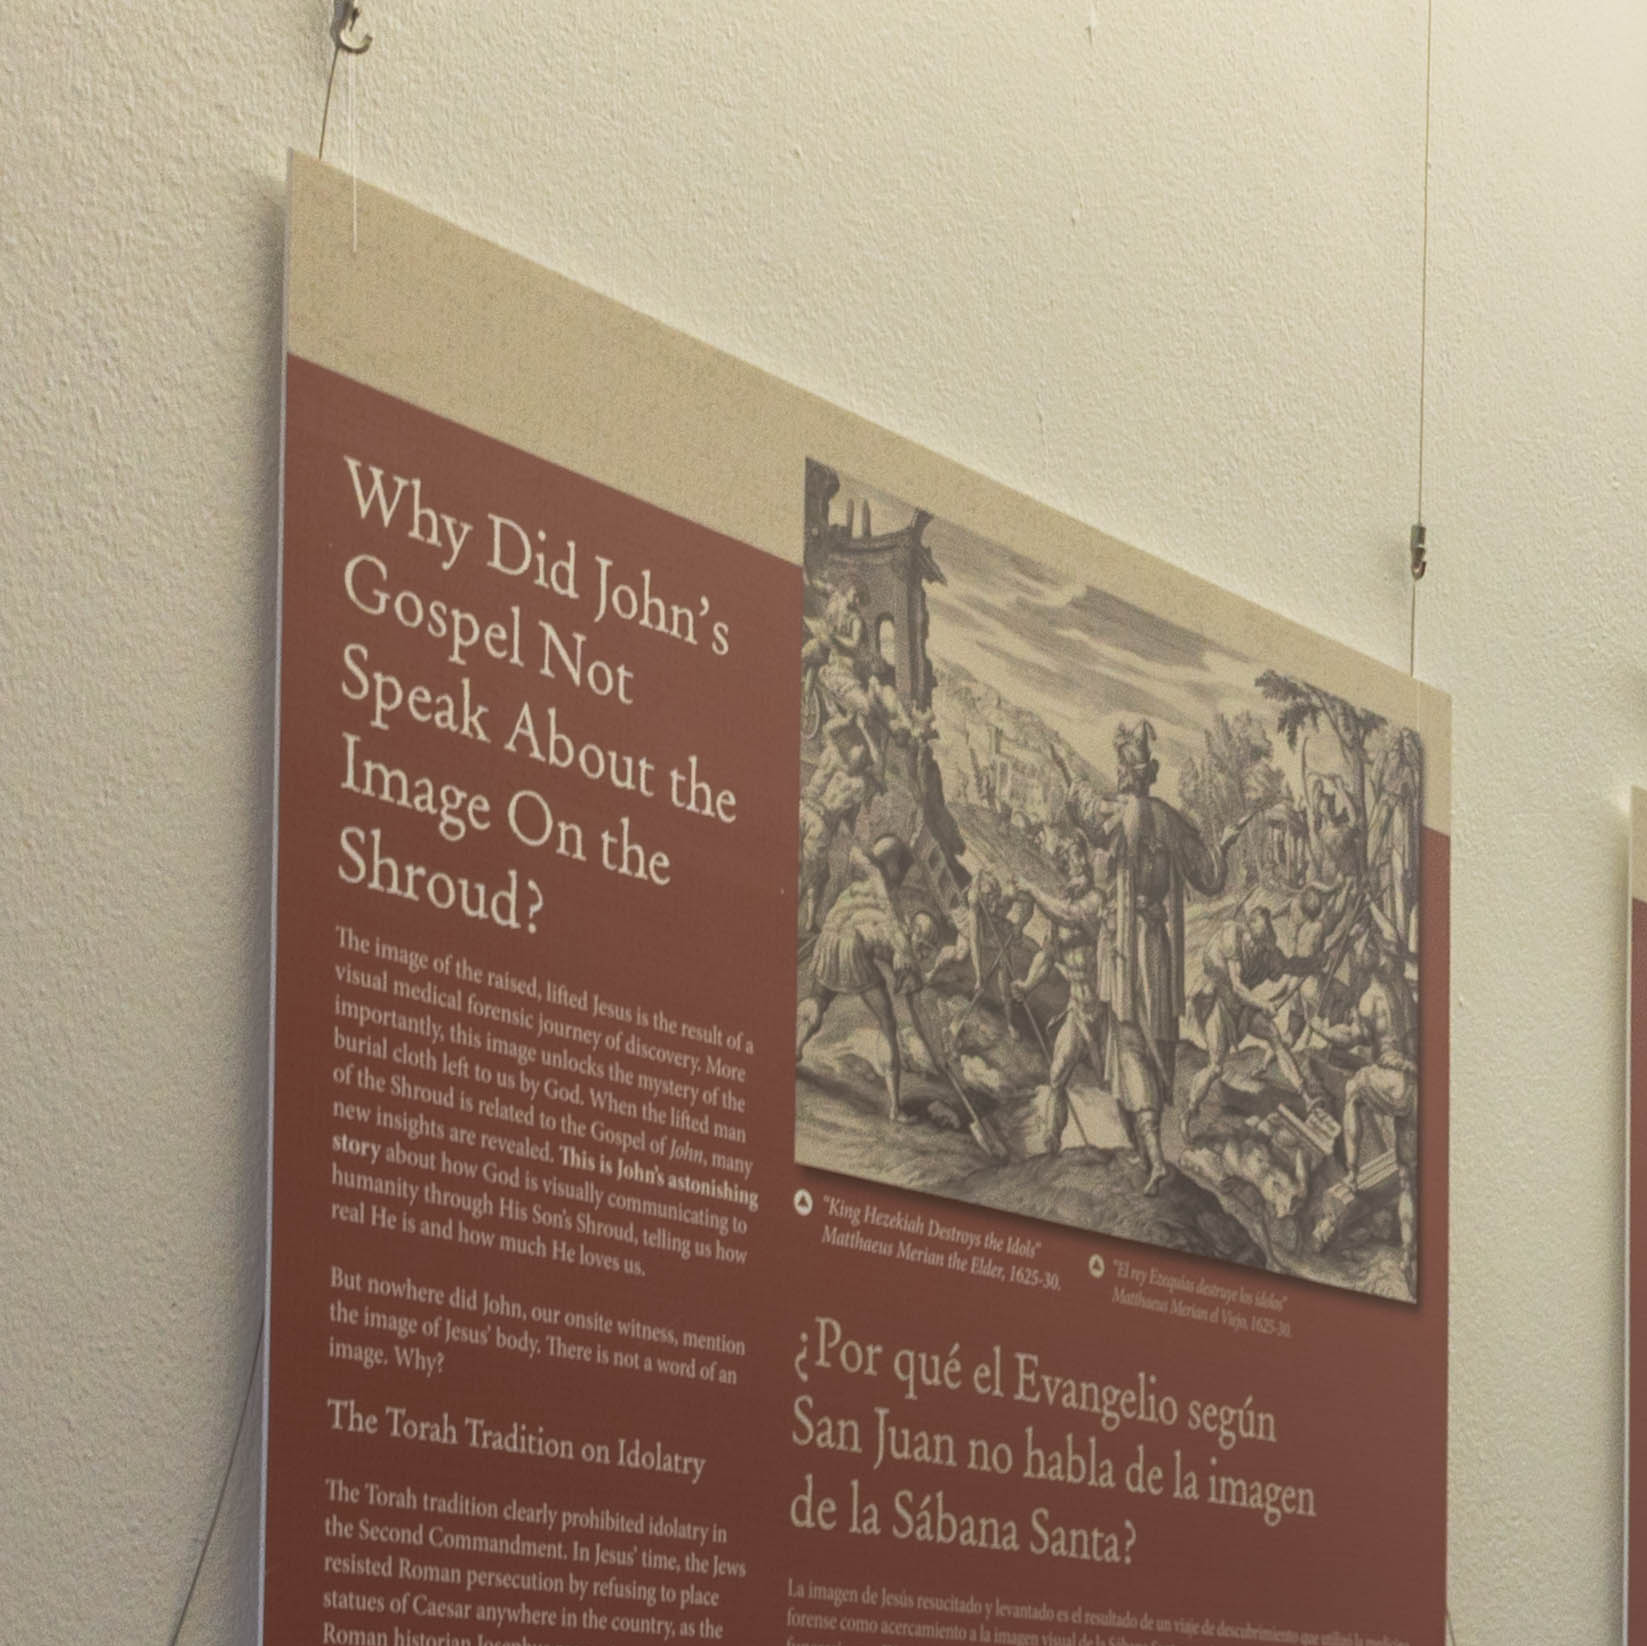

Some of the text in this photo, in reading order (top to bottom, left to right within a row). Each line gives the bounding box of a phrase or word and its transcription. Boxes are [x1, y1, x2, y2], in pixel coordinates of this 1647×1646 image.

[343, 455, 729, 656] Why Did John’s
[343, 553, 634, 705] Gospel Not
[340, 642, 736, 824] Speak About the
[340, 731, 670, 886] Image On the
[337, 825, 544, 934] Shroud?
[334, 924, 754, 1055] The image of the raised, lifted Jesus is the result of a
[820, 1223, 1061, 1291] Matthaeus Merian the Elder, 1625-30.
[862, 1204, 925, 1235] Hezekiah
[926, 1217, 981, 1249] Destroys
[982, 1230, 1004, 1252] the
[326, 1397, 706, 1484] The Torah Tradition on Idolatry
[793, 1315, 1277, 1451] ¿Por qué el Evangelio según
[788, 1472, 1137, 1565] de la Sábana Santa?
[791, 1393, 1316, 1527] San Juan no habla de la imagen
